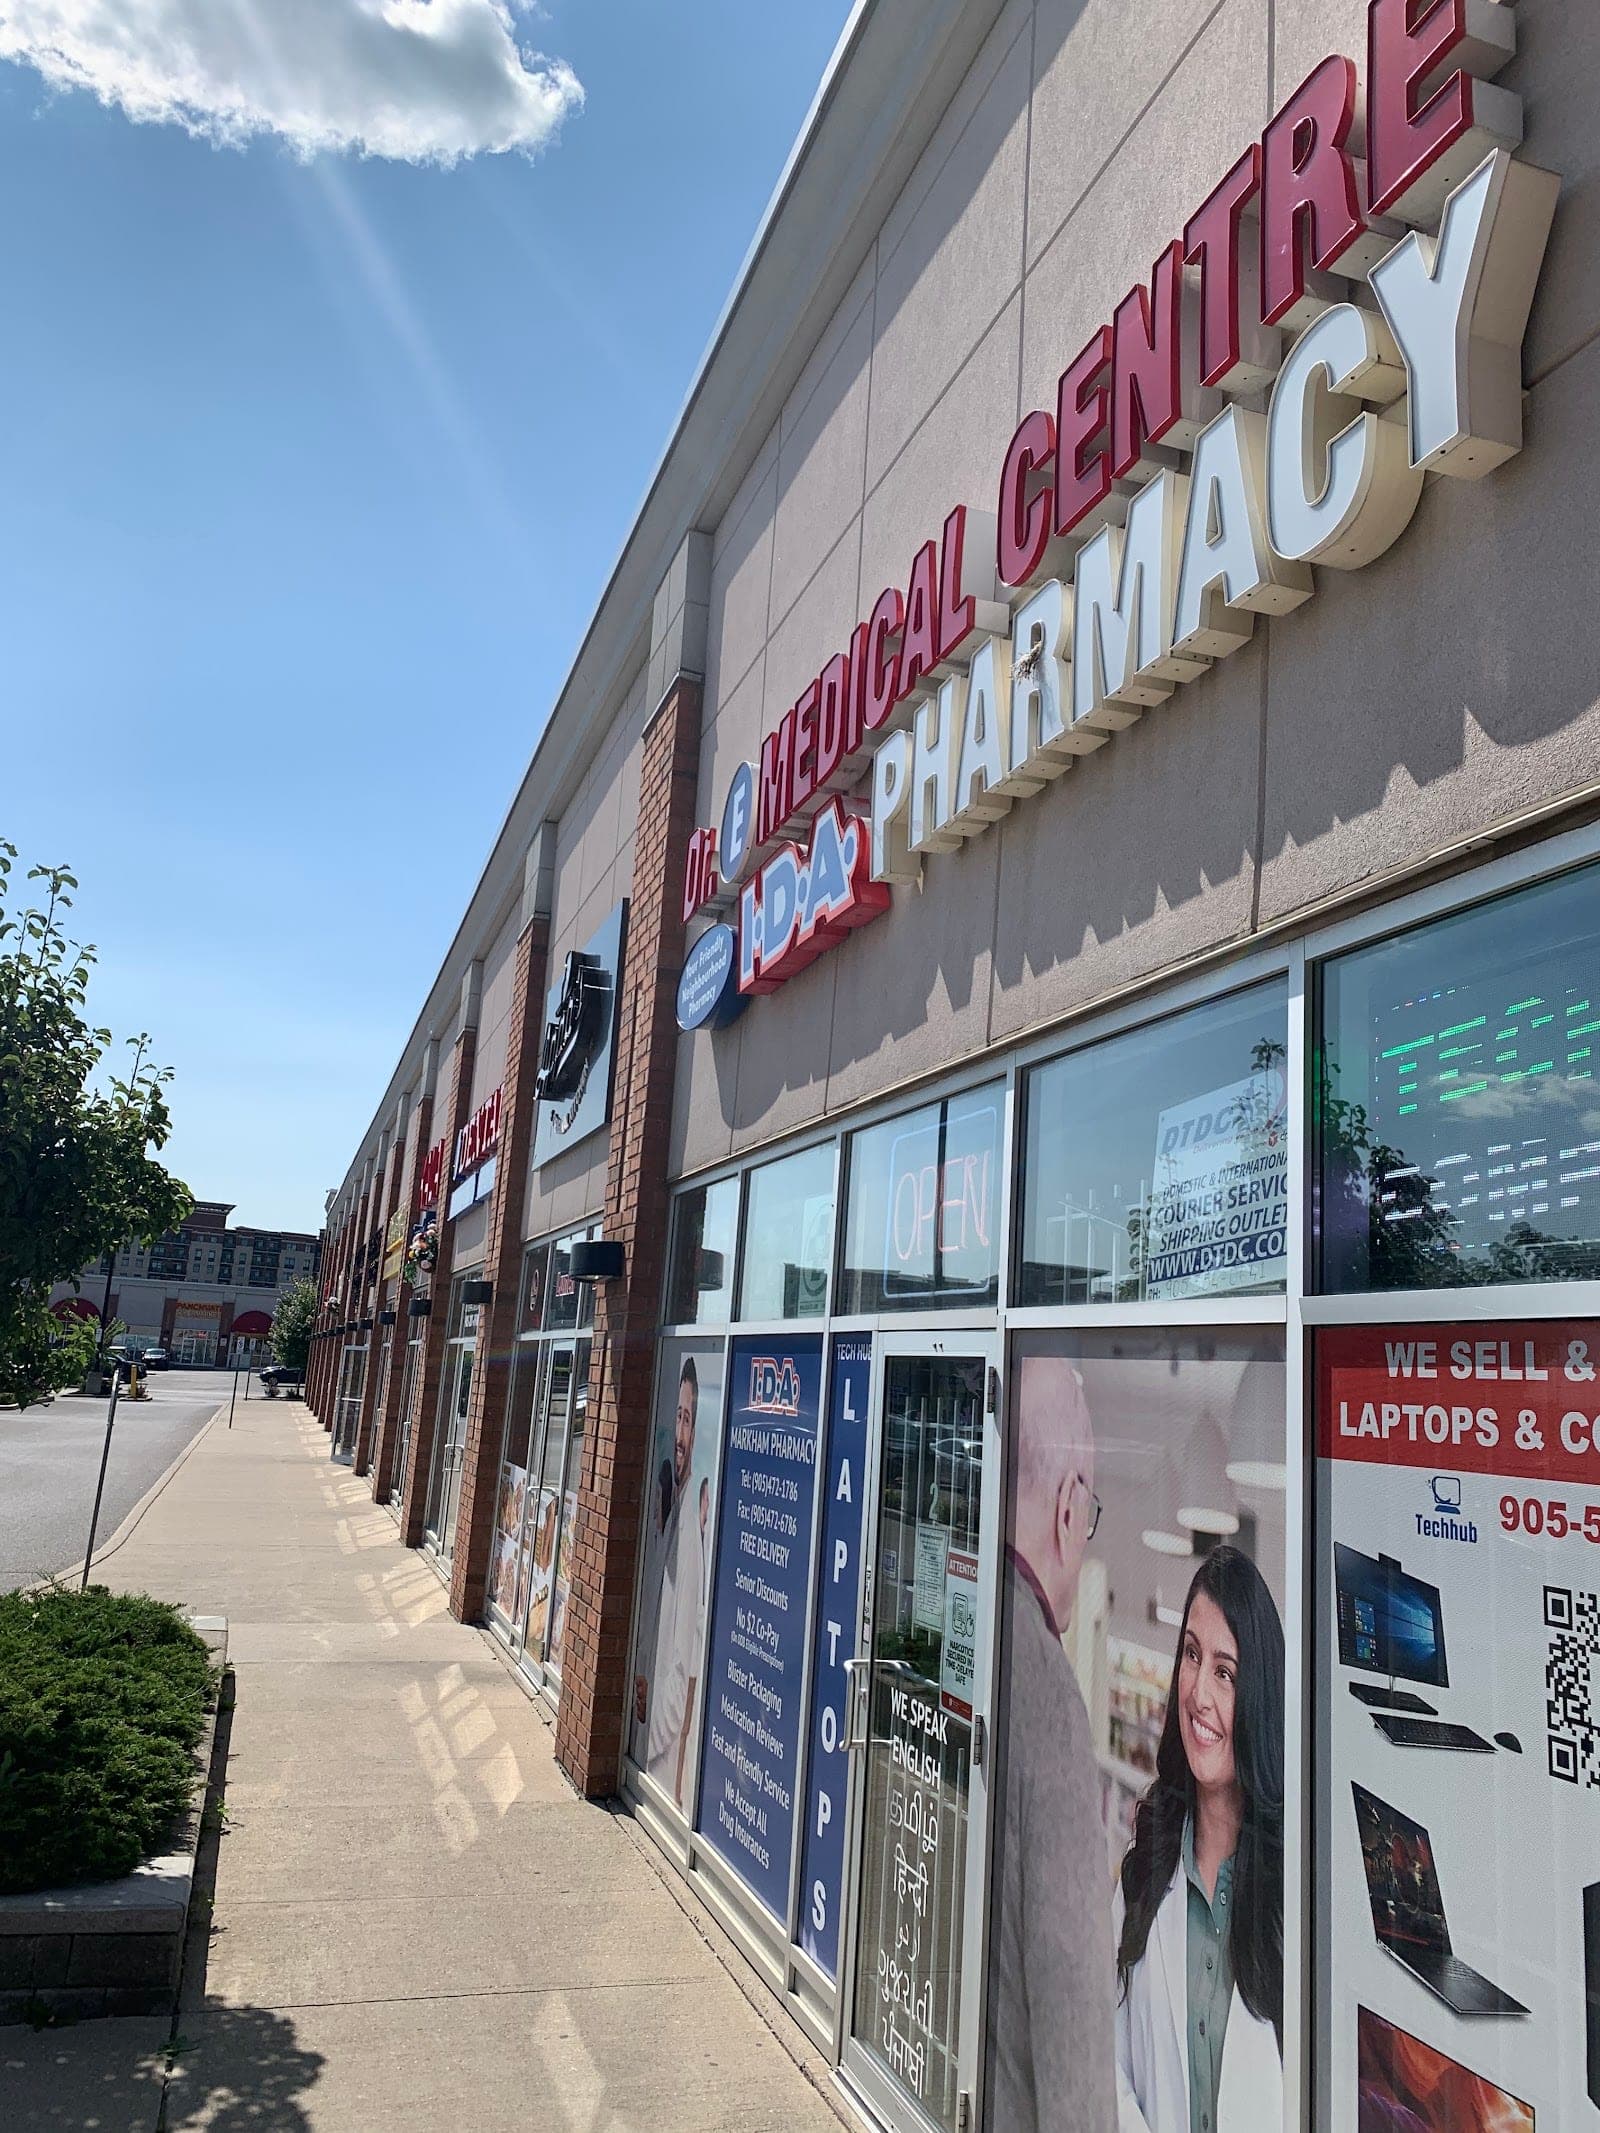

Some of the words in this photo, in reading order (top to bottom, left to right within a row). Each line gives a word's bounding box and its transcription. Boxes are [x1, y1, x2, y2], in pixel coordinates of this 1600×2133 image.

[756, 505, 975, 847] MEDICAL
[997, 0, 1473, 587] CENTRE
[870, 147, 1505, 884] PHARMACY
[700, 933, 724, 968] Friendly
[682, 948, 727, 1004] Neighbourhood
[688, 984, 717, 1019] Pharmacy
[1162, 1105, 1234, 1155] DTDC
[894, 1149, 991, 1261] OPEN
[1155, 1191, 1223, 1229] COURIER
[1163, 1174, 1208, 1201] DOMESTIC
[1160, 1218, 1226, 1253] SHIPPING
[837, 1343, 856, 1361] TECH
[1385, 1341, 1439, 1379] WE
[1450, 1340, 1549, 1381] SELL
[1563, 1339, 1596, 1383] &
[730, 1426, 769, 1456] MARKHAM
[771, 1433, 817, 1465] PHARMACY
[1340, 1402, 1500, 1447] LAPTOPS
[1514, 1409, 1545, 1451] &
[740, 1469, 751, 1488] Tel:
[737, 1500, 750, 1520] Fax:
[1415, 1513, 1478, 1543] Techhub
[739, 1532, 757, 1556] FREE
[757, 1536, 790, 1569] DELIVERY
[735, 1568, 756, 1596] Senior
[756, 1577, 789, 1611] Discounts
[736, 1606, 745, 1630] No
[746, 1610, 756, 1635] $2
[756, 1618, 779, 1654] Co-Pay
[727, 1659, 749, 1689] Blister
[748, 1672, 782, 1719] Packaging
[720, 1694, 755, 1738] Medication
[756, 1719, 784, 1760] Reviews
[891, 1687, 909, 1721] WE
[909, 1698, 948, 1746] SPEAK
[711, 1726, 724, 1755] Fast
[724, 1740, 737, 1764] and
[736, 1749, 763, 1792] Friendly
[763, 1770, 790, 1811] Service
[892, 1735, 941, 1790] ENGLISH
[725, 1777, 735, 1805] We
[735, 1788, 756, 1827] Accept
[889, 1789, 939, 1854] தமிழ்
[719, 1801, 735, 1838] Drug
[734, 1816, 770, 1870] Insurances
